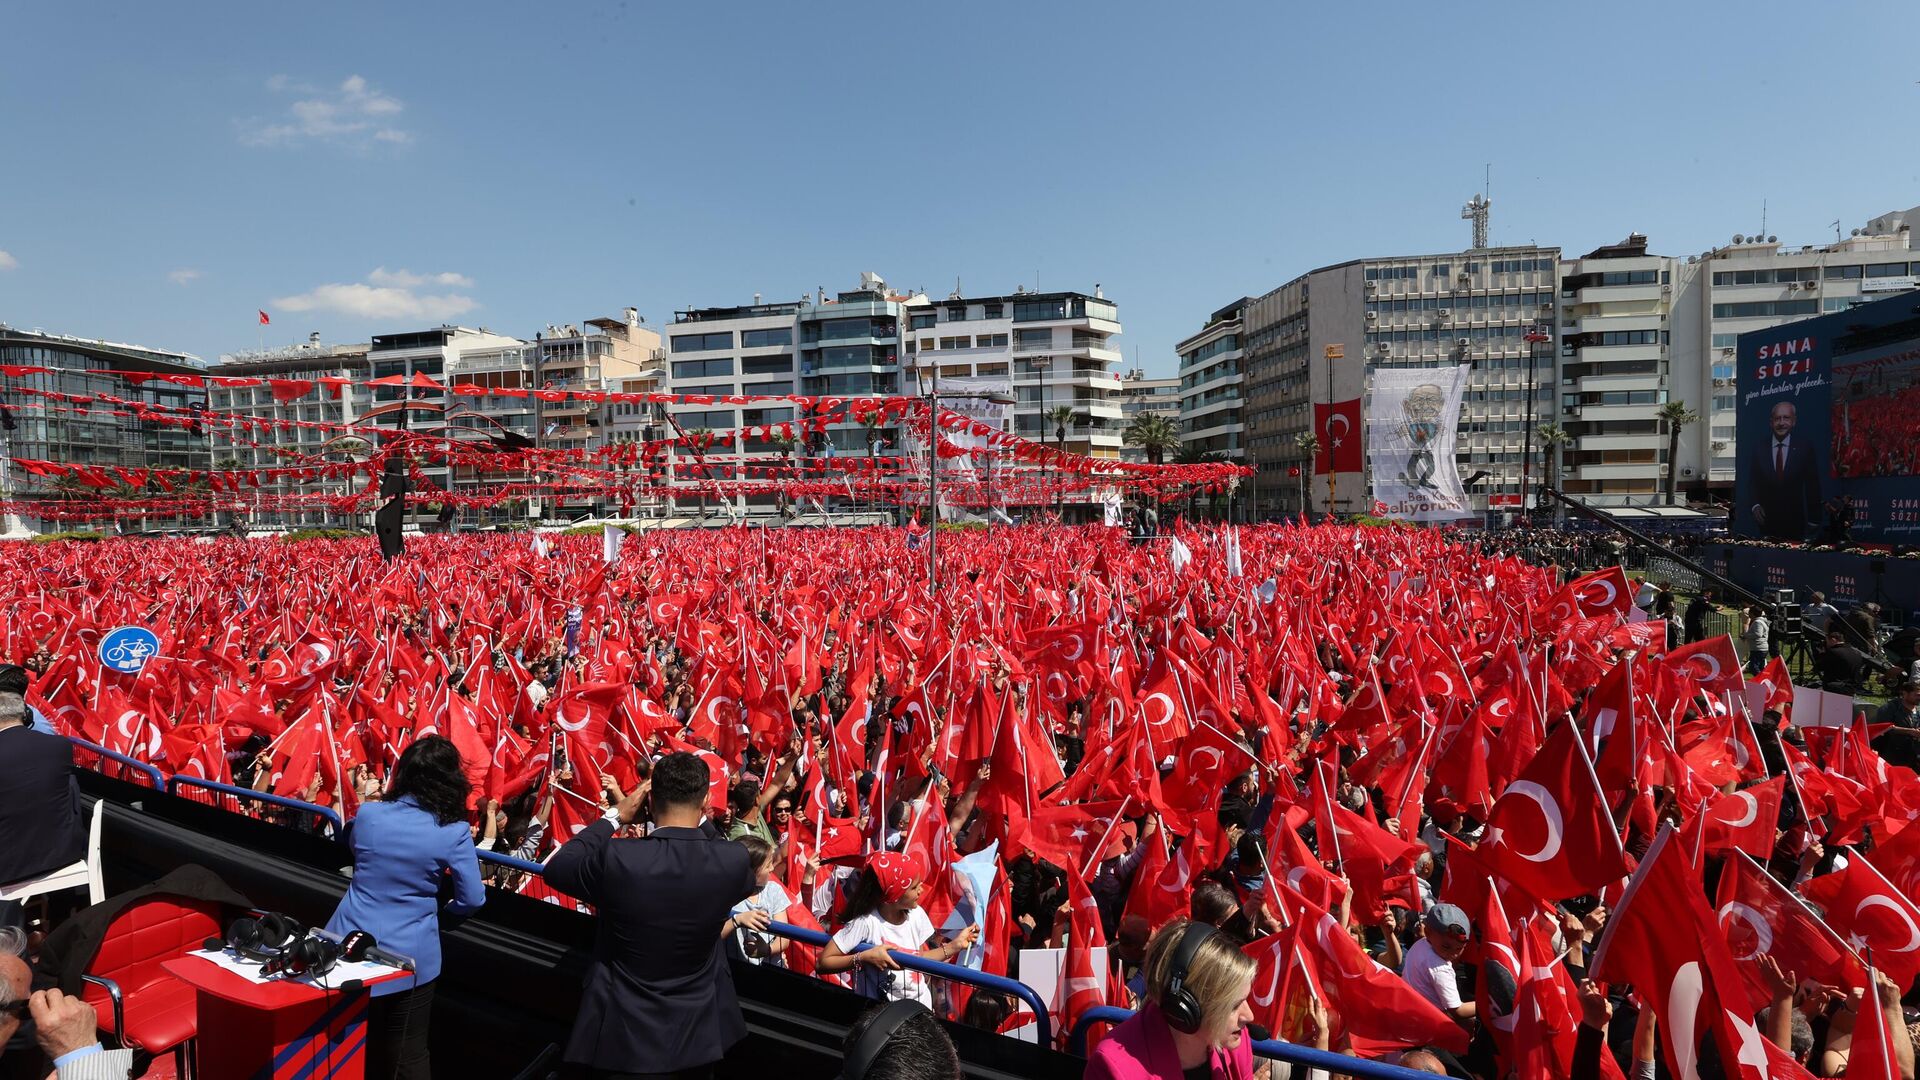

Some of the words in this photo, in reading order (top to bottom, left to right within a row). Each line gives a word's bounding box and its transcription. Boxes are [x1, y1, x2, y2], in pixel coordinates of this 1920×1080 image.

[1759, 337, 1811, 360] SANA
[1758, 358, 1810, 380] SÖZ!
[1745, 391, 1759, 406] yine
[1760, 380, 1793, 397] baharlar
[1795, 373, 1833, 396] gelecek...
[1408, 492, 1429, 502] Ben
[1891, 499, 1919, 509] SANA
[1890, 509, 1918, 522] SÖZ!
[1834, 575, 1855, 585] SANA
[1834, 584, 1855, 596] SÖZ!
